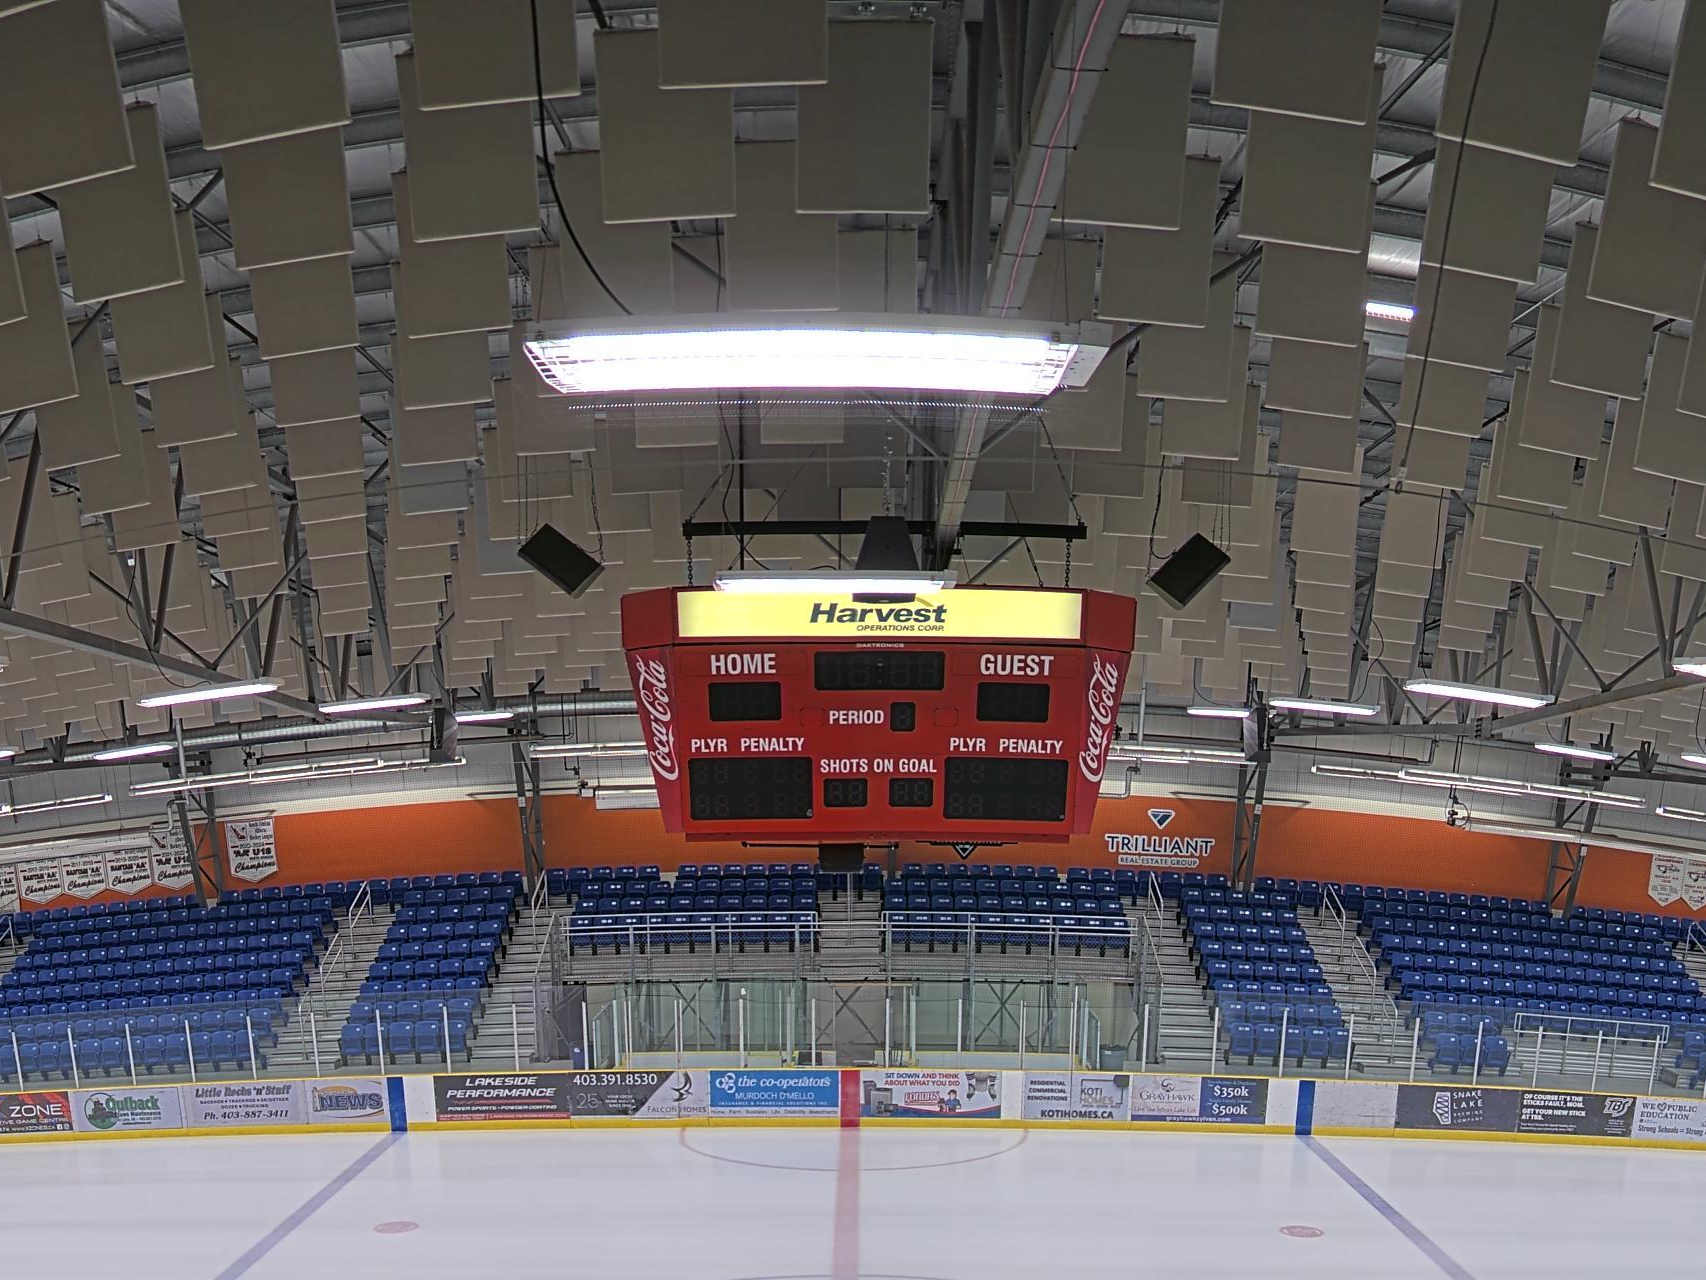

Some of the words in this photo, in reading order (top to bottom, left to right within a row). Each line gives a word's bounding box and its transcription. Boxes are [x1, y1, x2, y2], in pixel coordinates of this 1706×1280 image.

[809, 603, 947, 623] Harvest
[710, 654, 777, 675] HOME
[980, 654, 1054, 676] GUEST
[829, 710, 885, 725] PERIOD
[691, 739, 728, 753] PLYR
[740, 737, 805, 752] PENALTY
[949, 737, 986, 752] PLYR
[999, 738, 1063, 755] PENALTY
[820, 758, 868, 774] SHOTS
[873, 758, 894, 774] ON
[899, 759, 938, 774] GOAL
[1106, 835, 1213, 856] TRILLIANT
[235, 861, 276, 873] Champions
[1170, 858, 1198, 867] GROUP
[68, 878, 104, 890] Champions
[112, 874, 150, 886] Champions
[25, 884, 60, 896] Champions
[465, 1076, 538, 1086] LAKESIDE
[573, 1074, 657, 1086] 403.391.8530
[738, 1076, 756, 1087] the
[760, 1077, 831, 1089] co-operators
[195, 1087, 221, 1098] Little
[265, 1084, 292, 1095] Stuff
[446, 1087, 556, 1098] PERFORMANCE
[735, 1092, 777, 1100] MURDOCH
[779, 1092, 815, 1100] D'MELLO
[1081, 1087, 1103, 1096] KOTI
[1139, 1091, 1195, 1102] GRAYHAWK
[1213, 1085, 1249, 1098] $350k
[1453, 1090, 1482, 1099] SNAKE
[105, 1096, 160, 1111] Outback
[319, 1093, 384, 1110] NEWS
[1080, 1096, 1114, 1105] HOMES
[1453, 1099, 1483, 1109] LAKE
[9, 1104, 63, 1117] ZONE
[1212, 1104, 1248, 1116] $500k
[1603, 1097, 1634, 1117] TBS
[1642, 1102, 1656, 1110] WE
[1667, 1104, 1697, 1113] PUBLIC
[221, 1110, 289, 1120] 403-887-3411
[1040, 1109, 1114, 1119] KOTIHOMES.CA
[1640, 1111, 1690, 1121] EDUCATION
[1638, 1124, 1656, 1134] Strong
[1658, 1126, 1679, 1134] Schools
[1685, 1127, 1703, 1137] Strong
